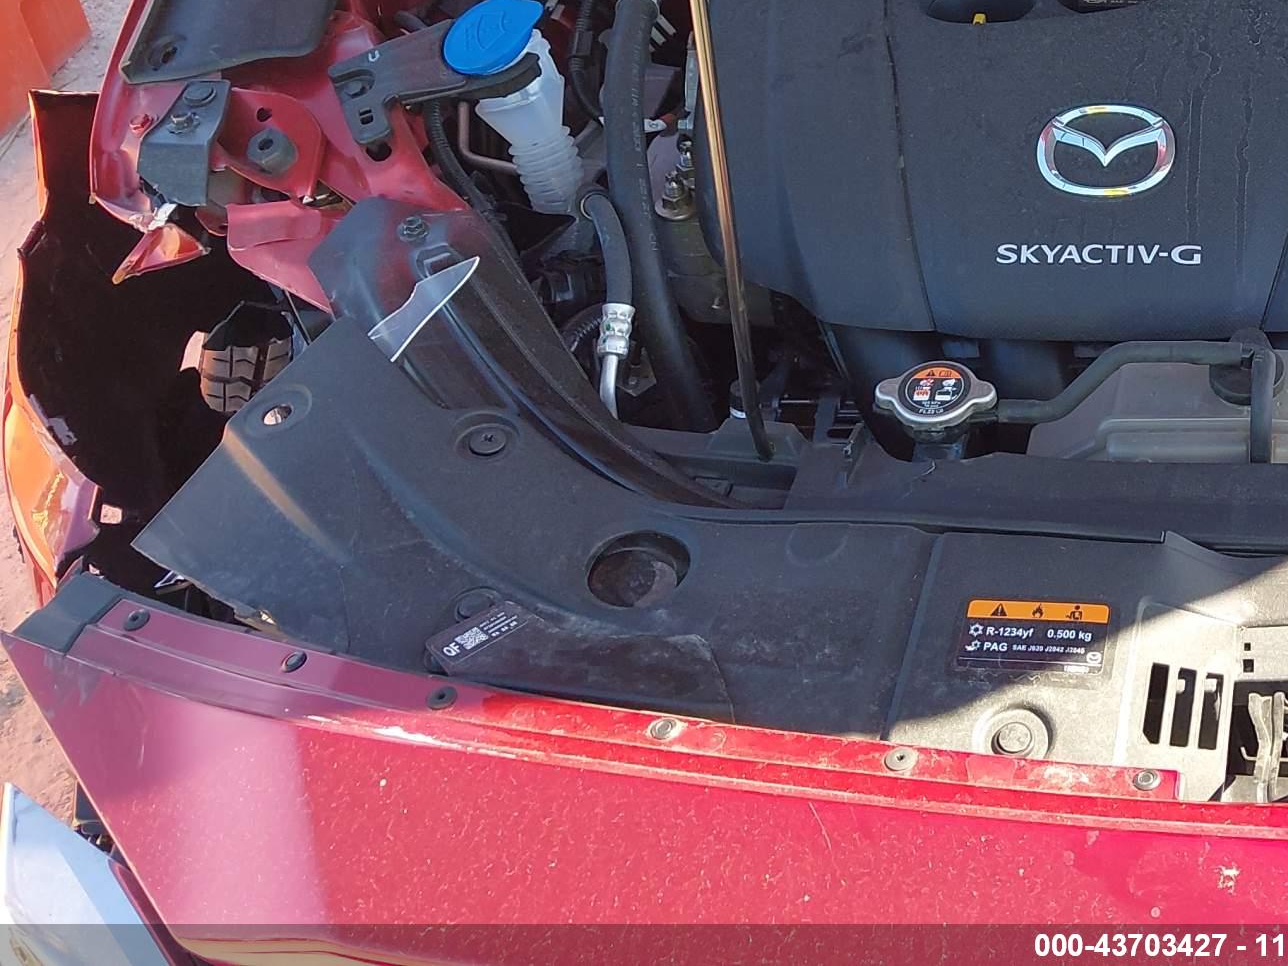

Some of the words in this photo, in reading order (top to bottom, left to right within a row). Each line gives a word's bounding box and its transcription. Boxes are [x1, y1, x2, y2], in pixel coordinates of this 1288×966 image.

[996, 243, 1202, 265] SKYACTIV-G
[986, 626, 1034, 639] R-1234yf
[1047, 629, 1076, 639] 0.500
[1078, 630, 1092, 642] kg
[442, 641, 461, 656] QF
[983, 642, 1008, 652] PAG
